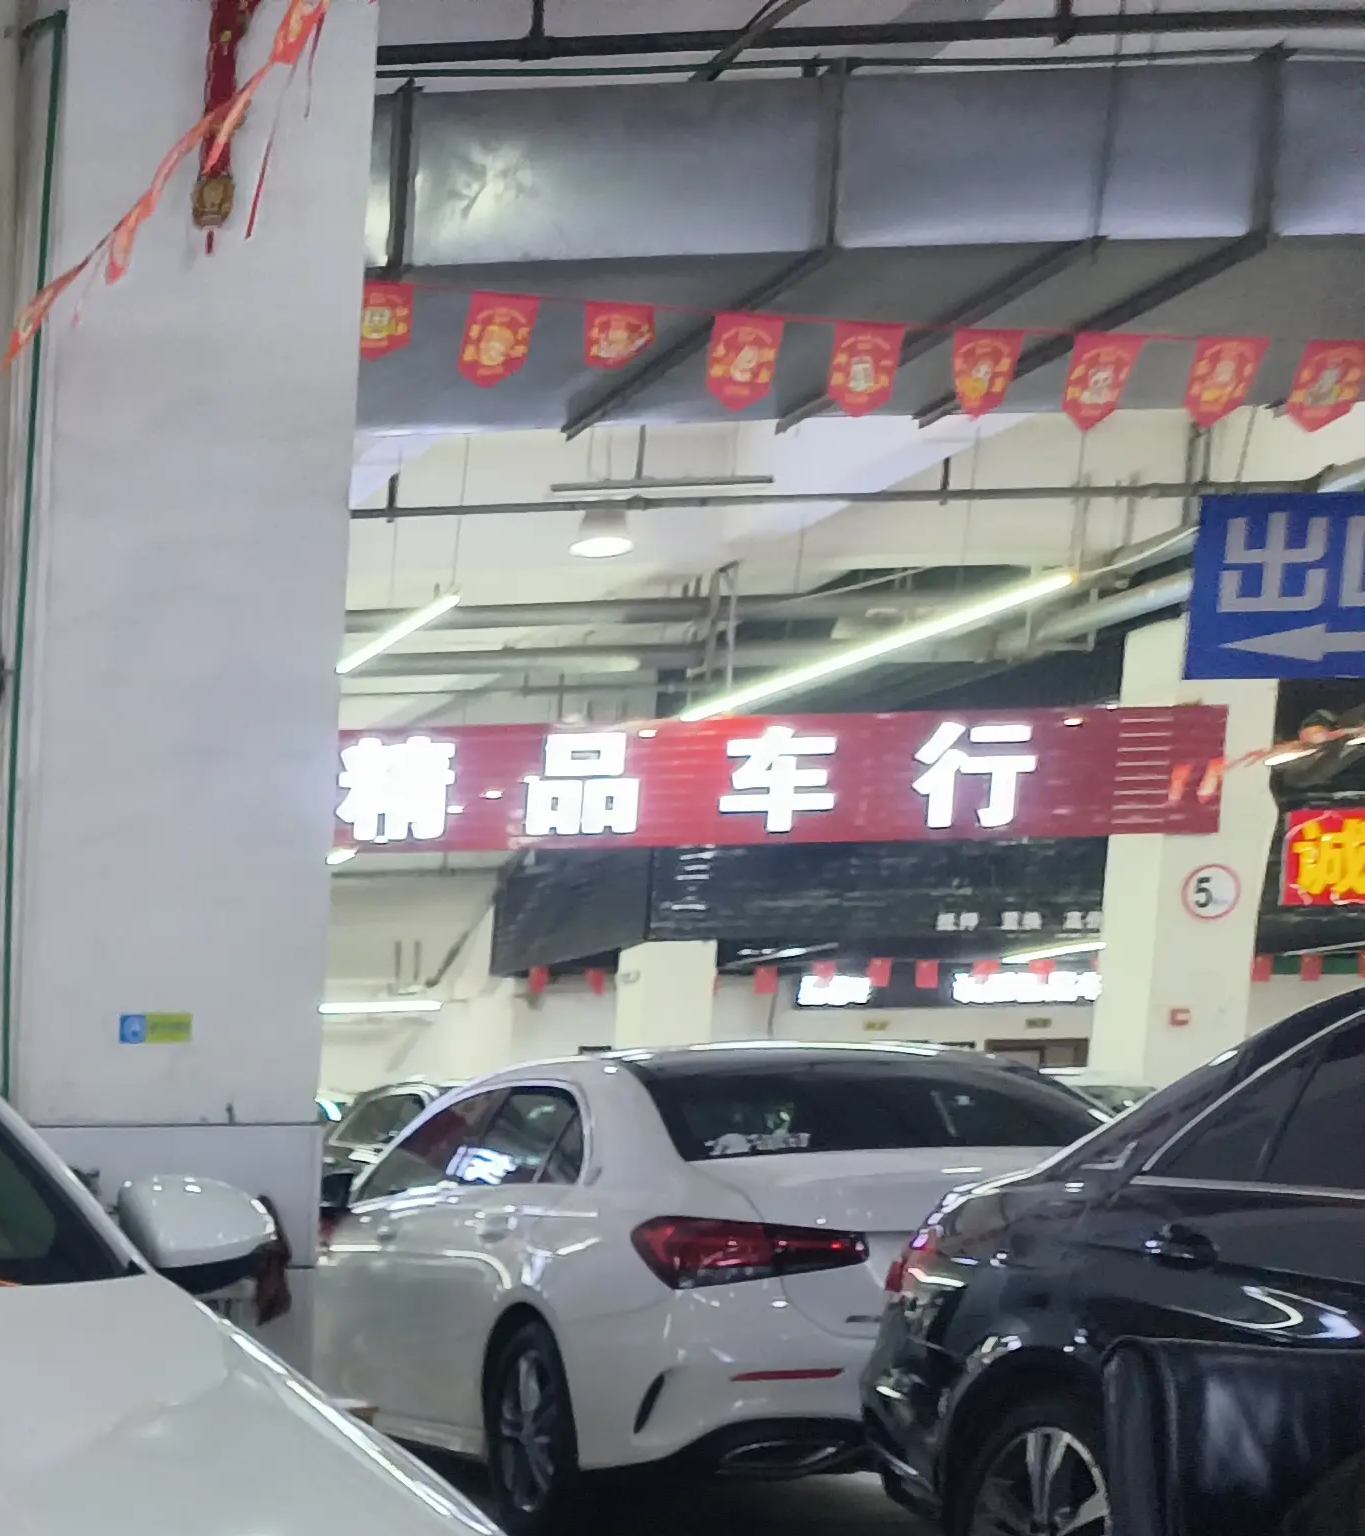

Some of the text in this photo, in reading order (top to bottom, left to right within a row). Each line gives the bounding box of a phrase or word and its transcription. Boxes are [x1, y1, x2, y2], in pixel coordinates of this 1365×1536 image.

[1216, 511, 1365, 613] 出
[336, 721, 1038, 841] 精品车行
